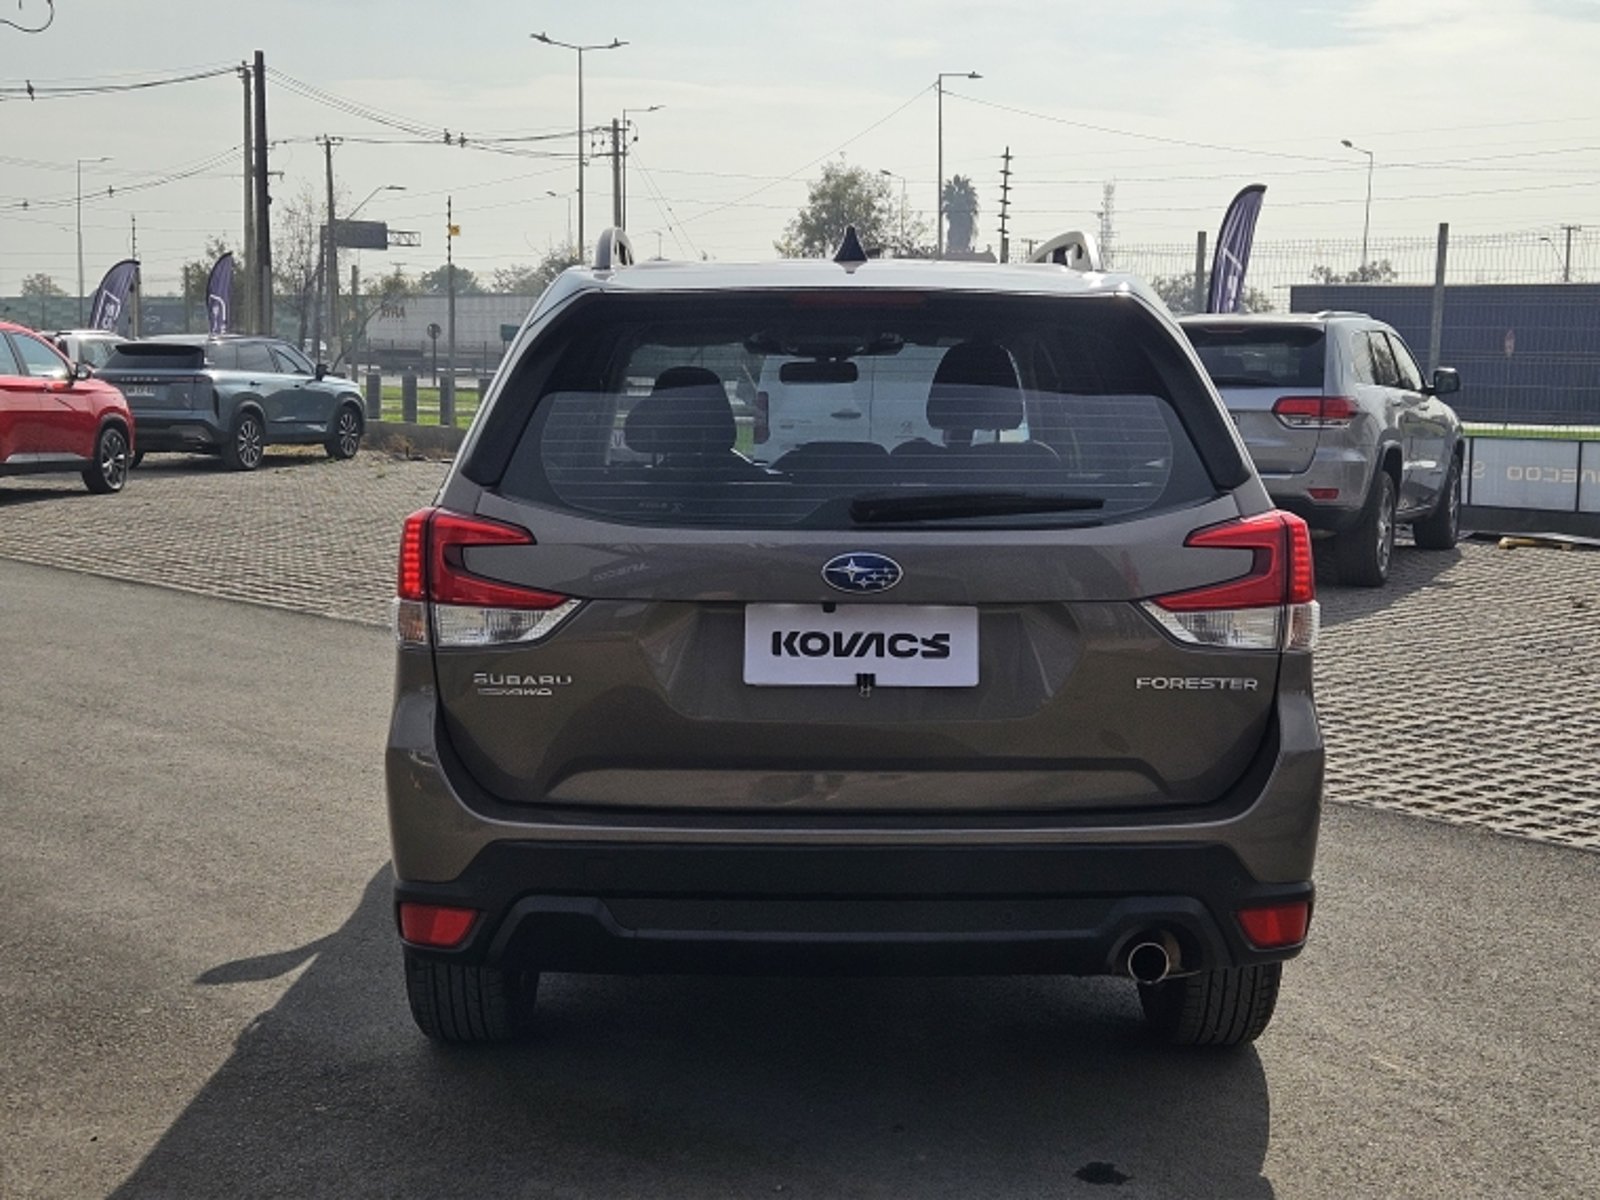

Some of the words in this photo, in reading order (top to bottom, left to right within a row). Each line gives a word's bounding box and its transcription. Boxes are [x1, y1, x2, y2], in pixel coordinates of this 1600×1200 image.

[772, 631, 950, 658] KOVACS
[473, 672, 572, 685] SUBARU
[1135, 677, 1258, 691] FORESTER
